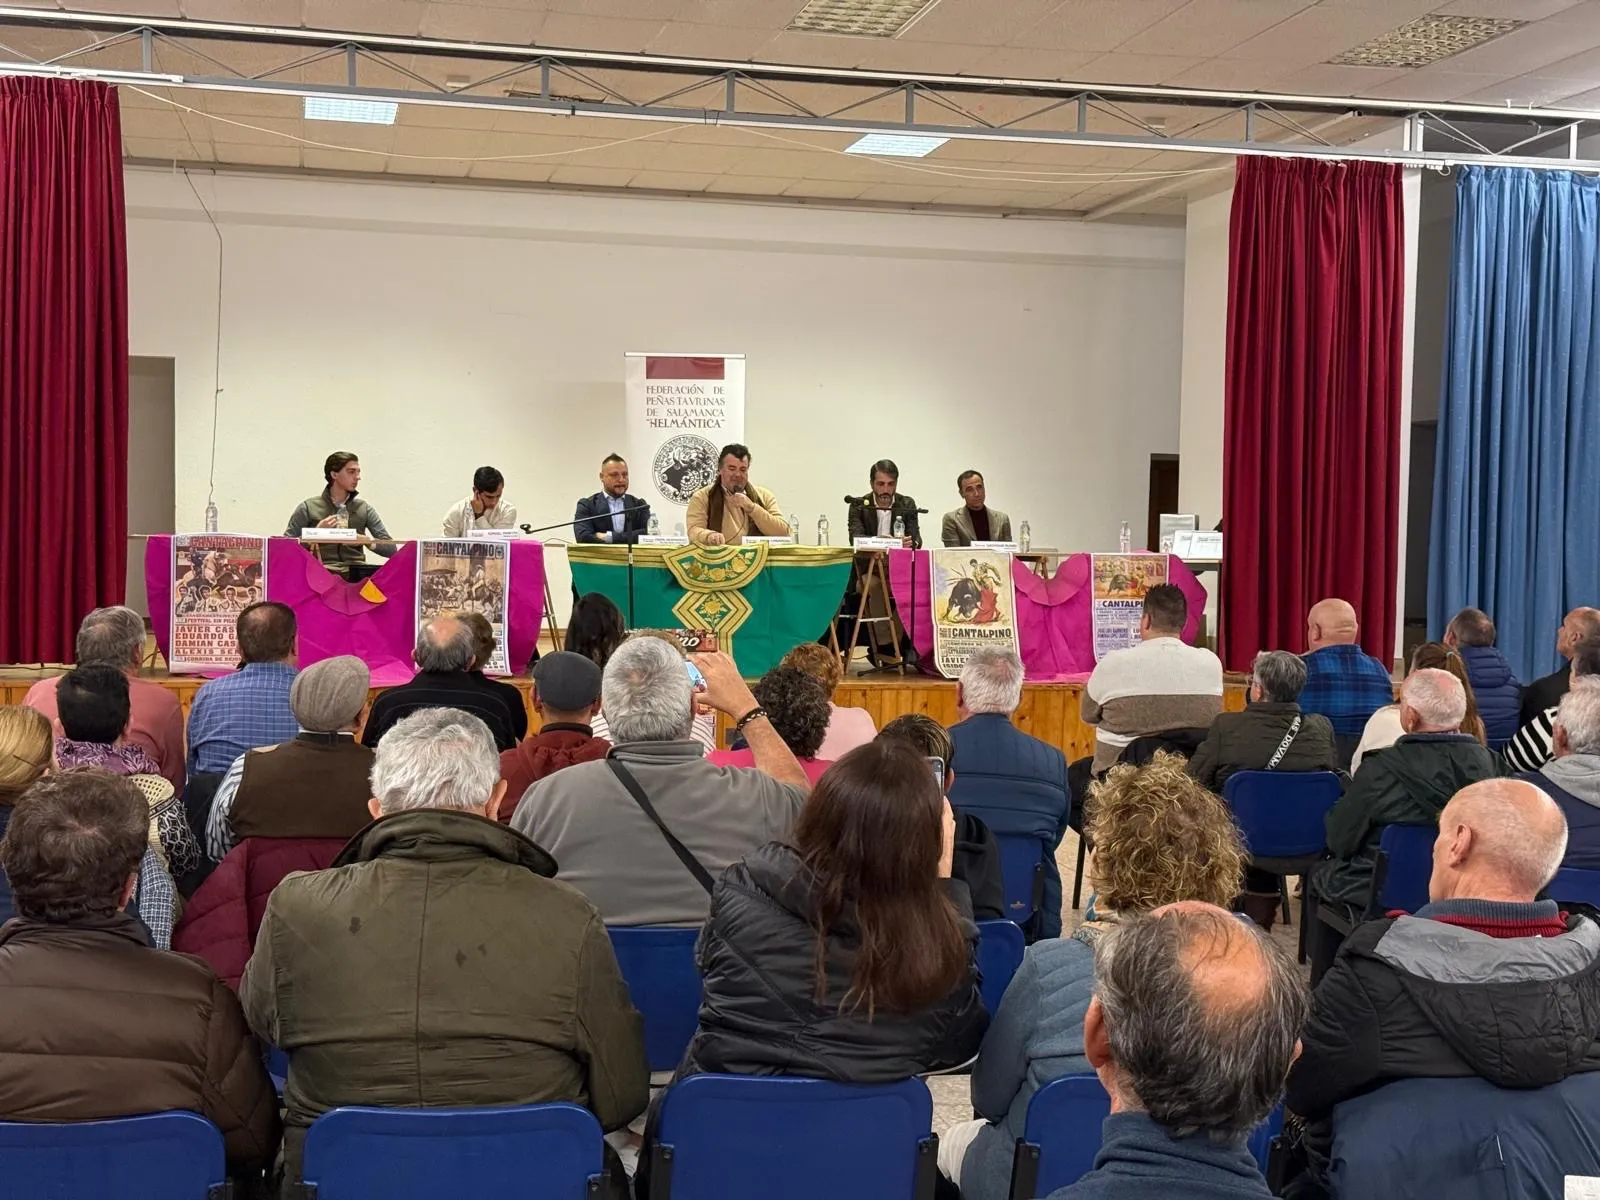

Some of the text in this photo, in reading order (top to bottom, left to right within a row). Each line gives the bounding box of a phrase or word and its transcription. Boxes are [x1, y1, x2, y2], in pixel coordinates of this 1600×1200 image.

[713, 386, 725, 395] DE
[646, 395, 675, 406] PEÑAS
[646, 408, 725, 417] DE SALAMANCA
[436, 542, 495, 556] CANTALPINO
[1102, 600, 1144, 608] CANTALPI
[952, 627, 1012, 638] CANTALPINO
